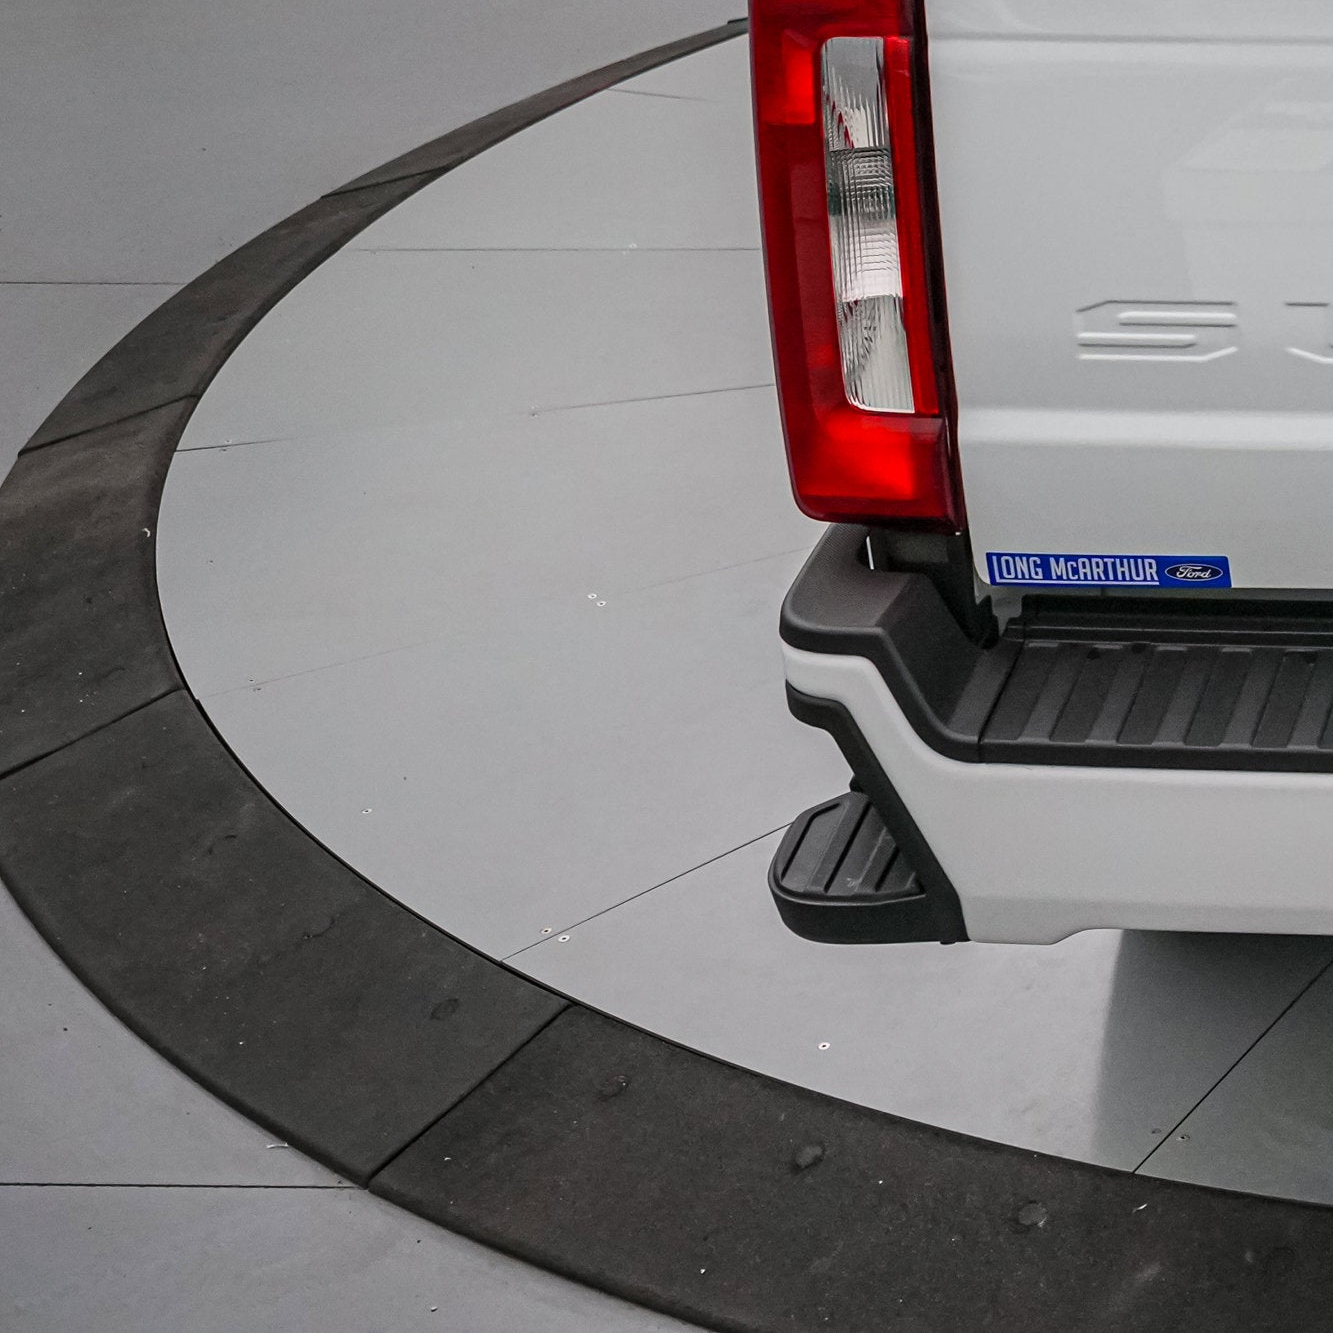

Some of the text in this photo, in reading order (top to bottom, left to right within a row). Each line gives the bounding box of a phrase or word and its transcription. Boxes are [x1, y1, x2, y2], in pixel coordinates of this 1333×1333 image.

[992, 555, 1213, 582] LONG McARTHUR Ford
